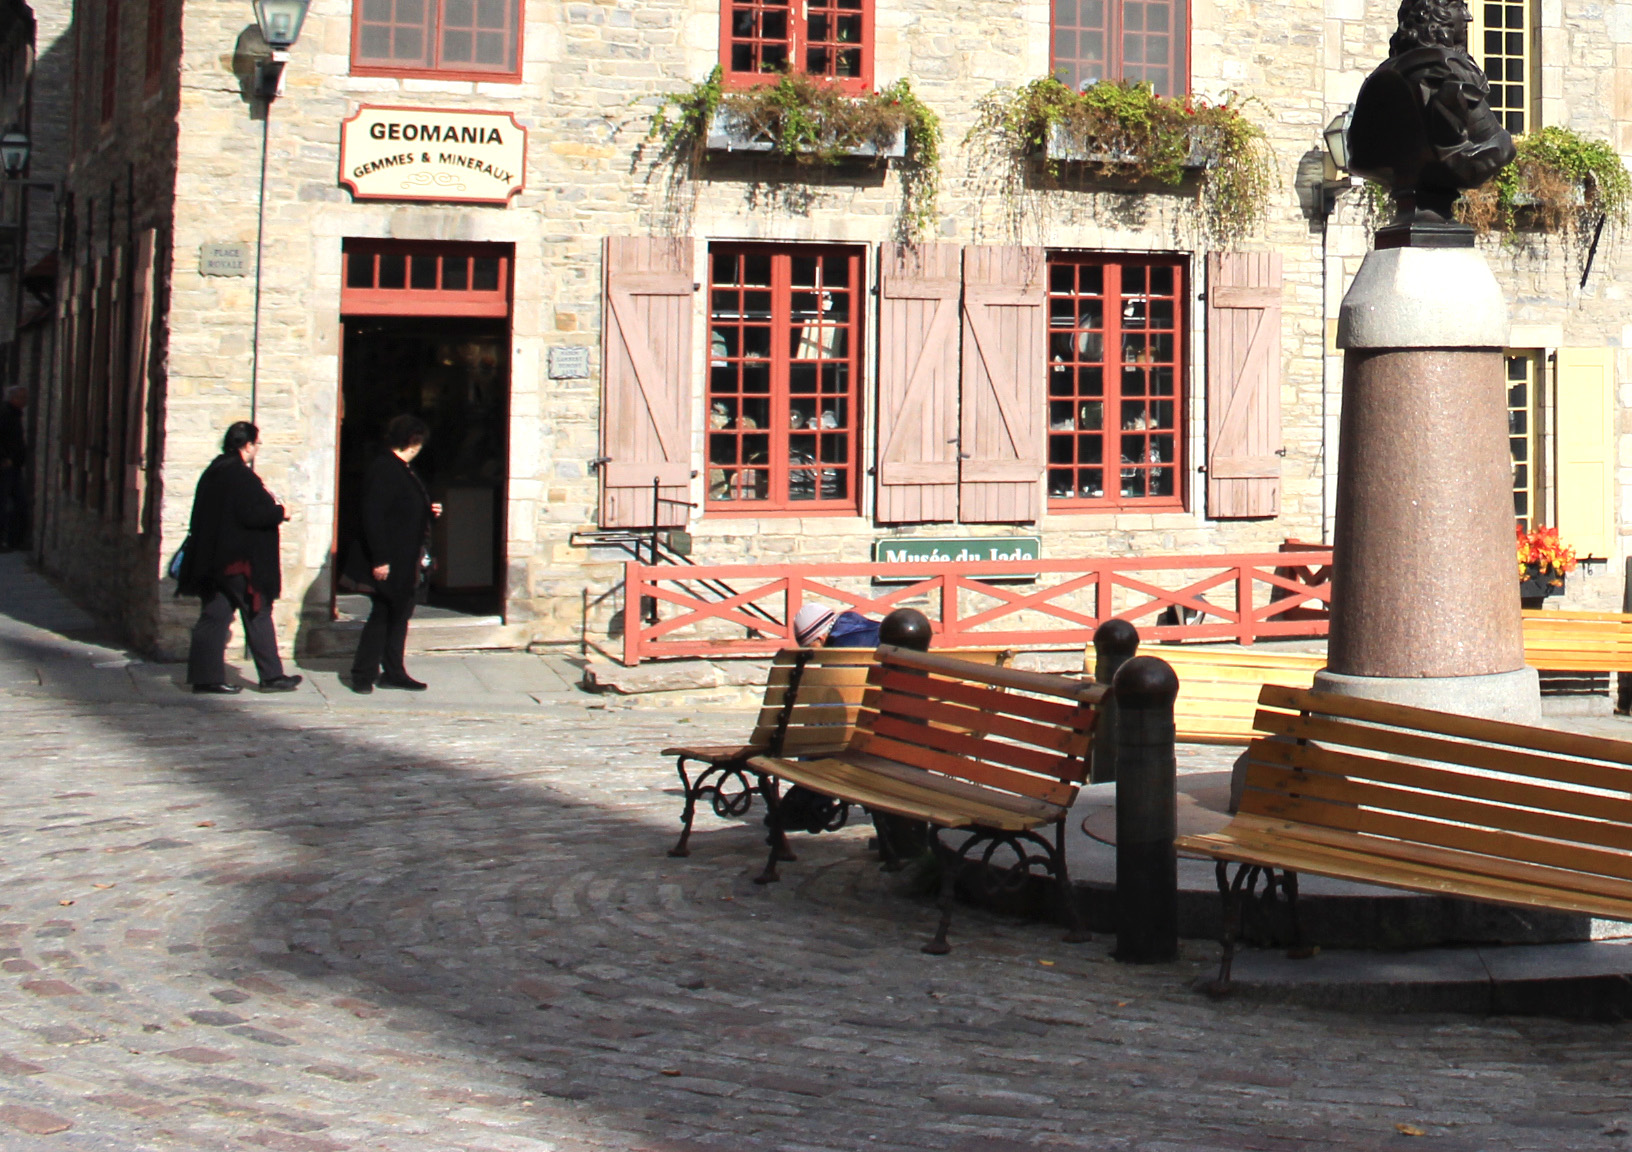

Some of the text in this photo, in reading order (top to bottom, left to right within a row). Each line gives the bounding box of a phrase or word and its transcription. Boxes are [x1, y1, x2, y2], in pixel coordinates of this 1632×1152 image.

[370, 122, 503, 145] GEOMANIA
[353, 151, 514, 185] GEMMES & MINERAUX
